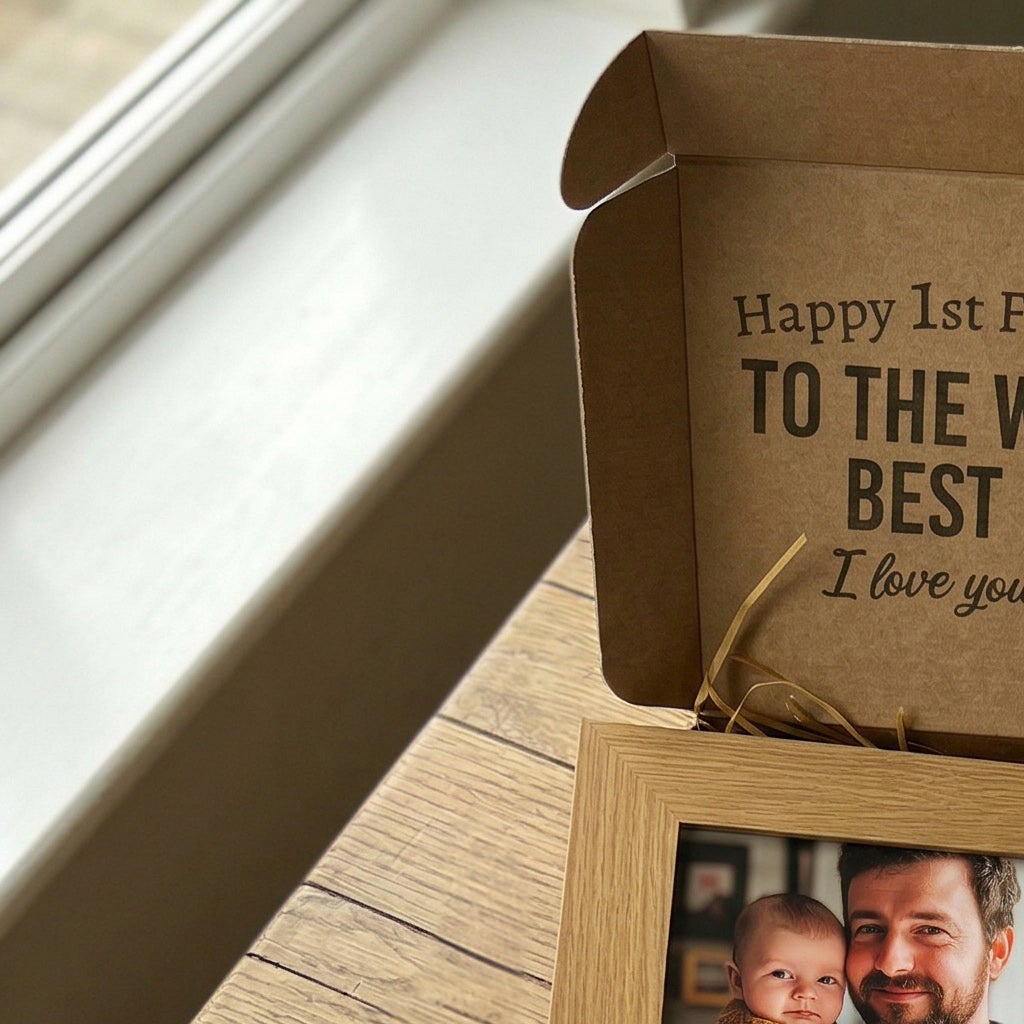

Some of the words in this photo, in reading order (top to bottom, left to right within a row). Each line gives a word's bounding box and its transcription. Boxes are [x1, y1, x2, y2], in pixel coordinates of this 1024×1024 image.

[733, 292, 895, 344] Happy
[910, 282, 985, 331] 1st
[741, 358, 821, 439] TO
[844, 365, 970, 447] THE
[847, 458, 1003, 539] BEST
[822, 548, 867, 601] I
[869, 552, 955, 600] love
